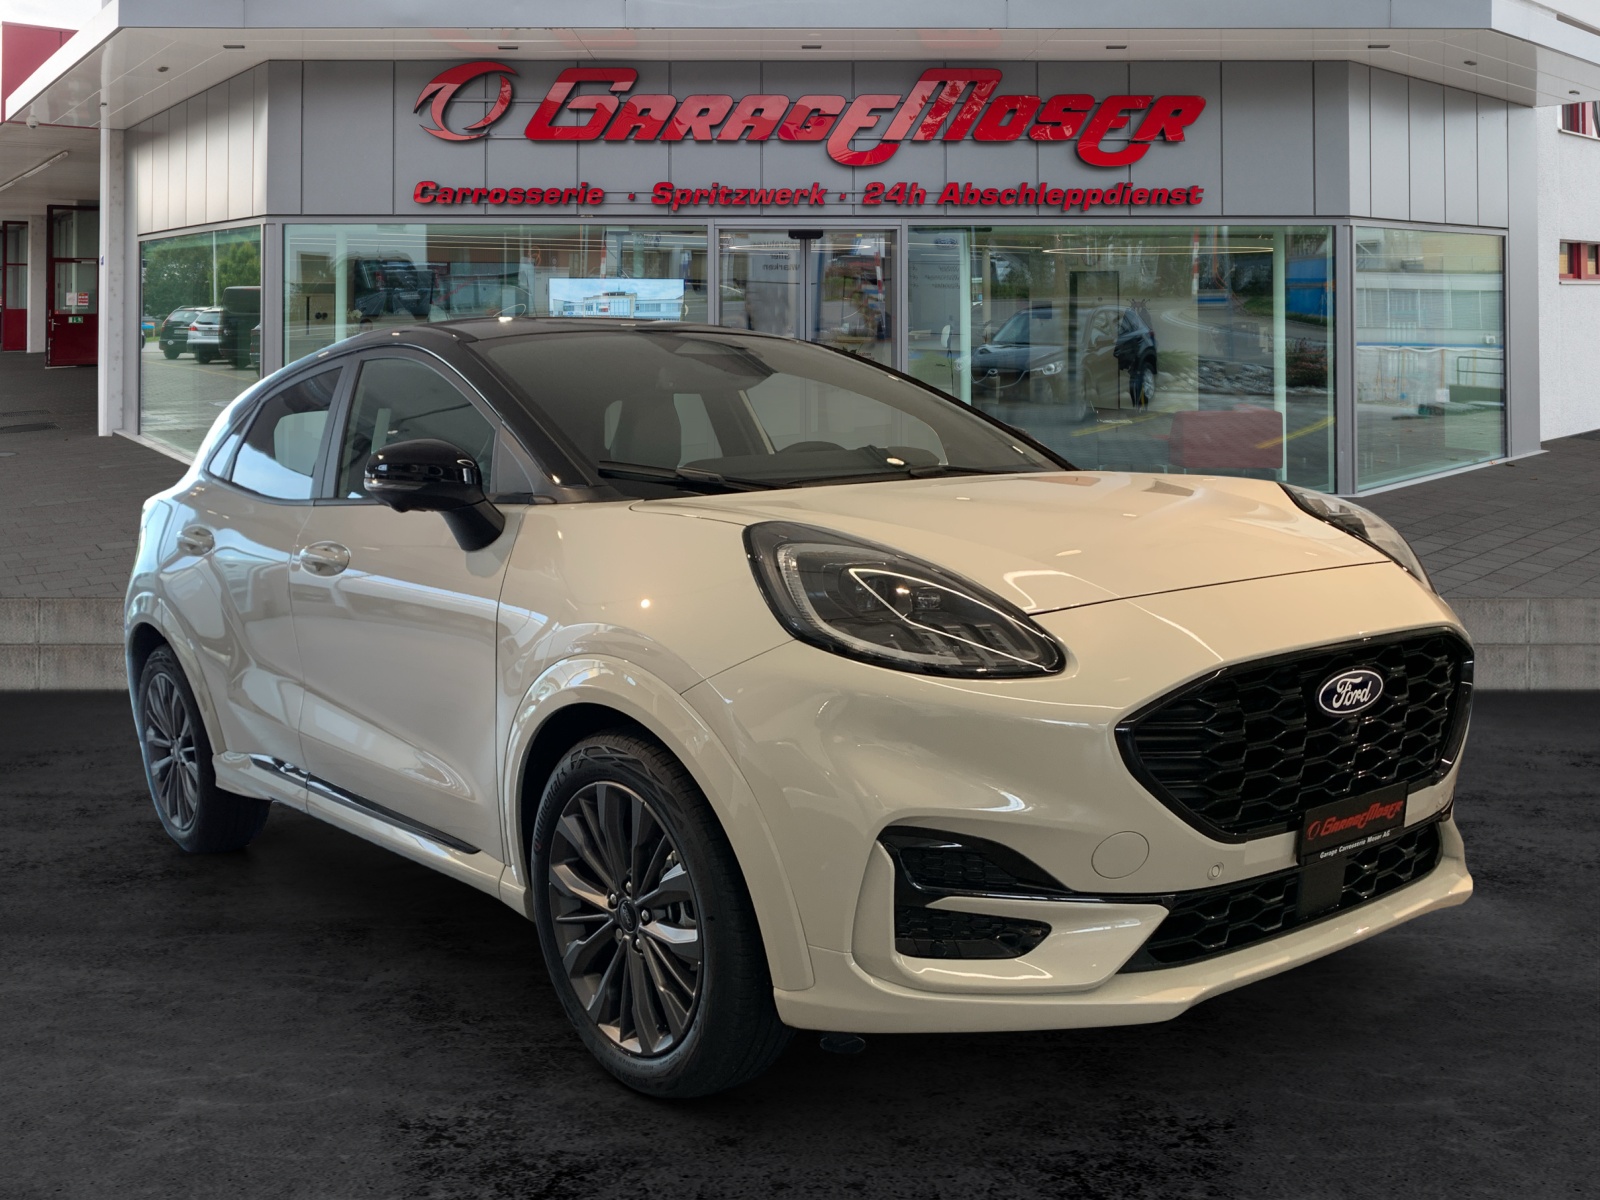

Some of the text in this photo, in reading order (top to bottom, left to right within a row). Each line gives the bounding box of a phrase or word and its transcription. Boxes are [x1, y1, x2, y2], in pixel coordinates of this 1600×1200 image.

[413, 181, 1203, 211] Carrosserie Spritzwerk 24h Abschleppdienst
[1332, 676, 1372, 708] Ford
[1320, 848, 1338, 859] Garage
[1382, 830, 1391, 838] AG
